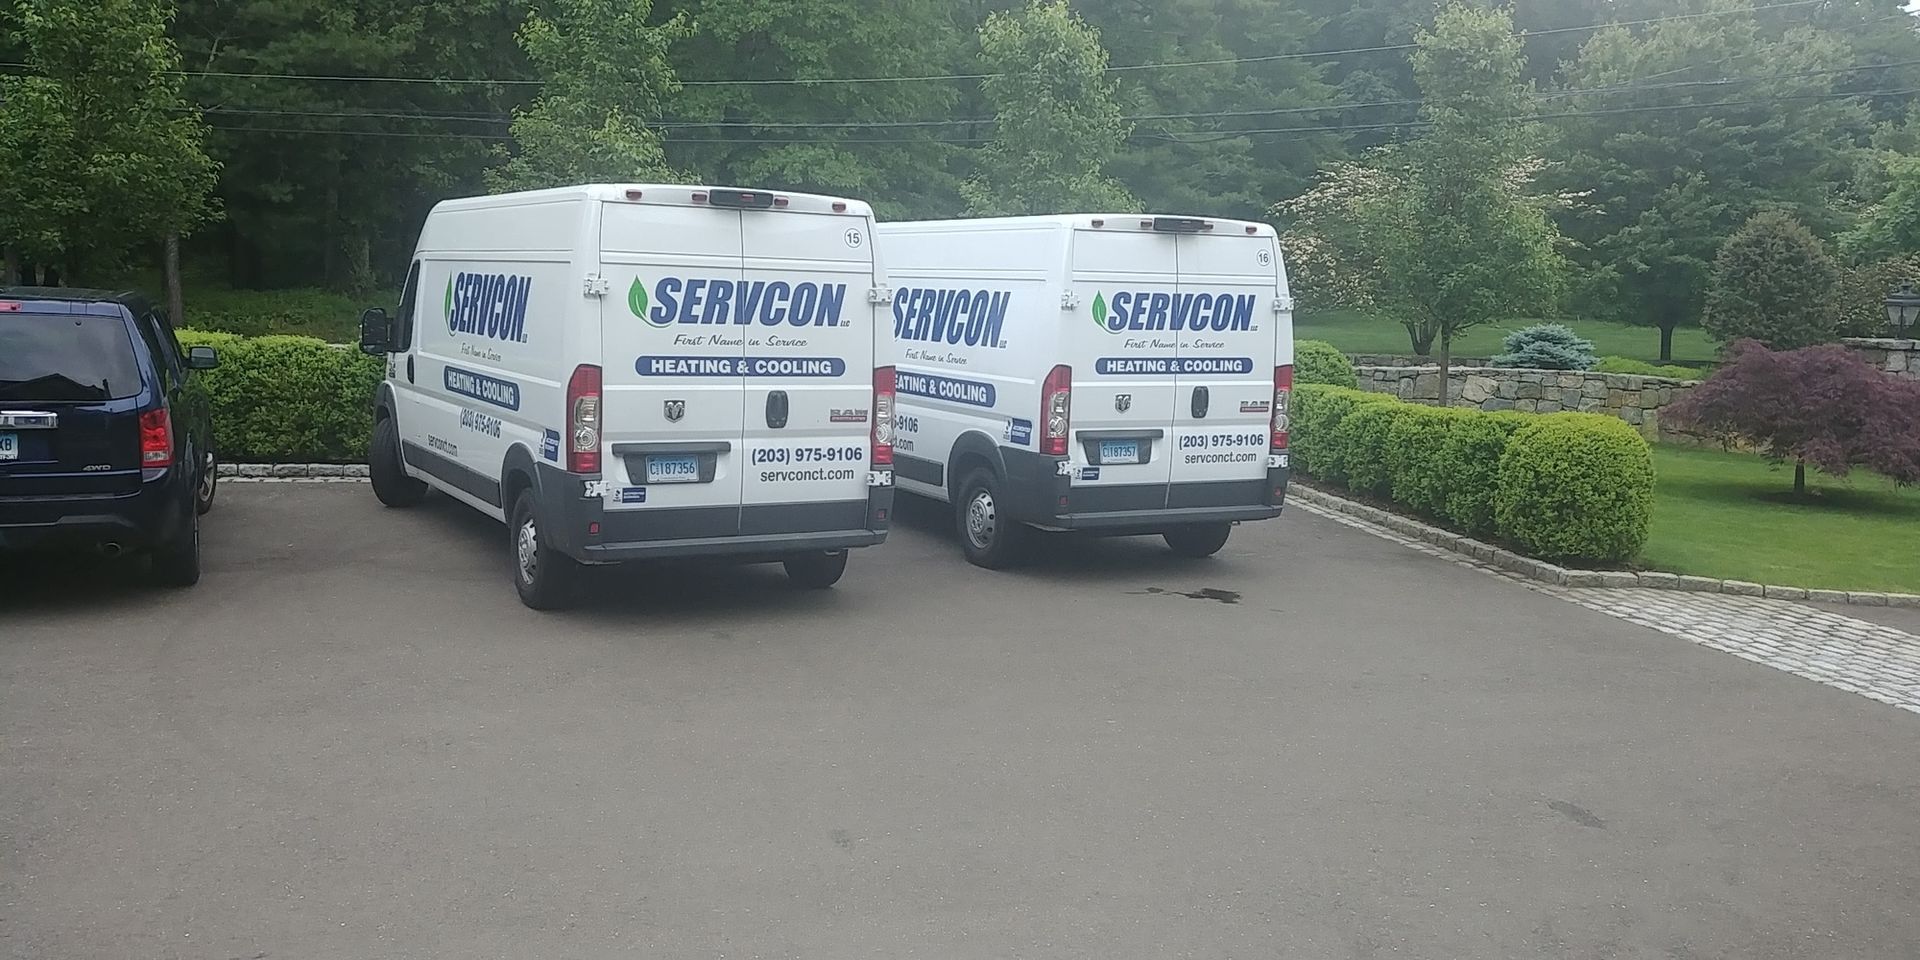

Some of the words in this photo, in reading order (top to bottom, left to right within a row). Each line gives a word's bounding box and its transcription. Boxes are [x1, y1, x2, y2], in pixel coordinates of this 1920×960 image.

[847, 232, 860, 245] 15
[1258, 252, 1269, 263] 16
[450, 272, 532, 342] SERVCON
[650, 277, 847, 327] SERVCON
[892, 287, 1011, 348] SERVCON
[1108, 291, 1256, 332] SERVCON
[673, 333, 706, 346] First
[708, 334, 744, 346] Name
[749, 337, 760, 347] in
[765, 335, 808, 347] Service
[1124, 338, 1148, 349] First
[1150, 338, 1176, 349] Name
[1180, 340, 1189, 349] in
[1193, 338, 1225, 349] Service
[651, 359, 731, 374] HEATING
[736, 360, 749, 374] &
[754, 359, 832, 375] COOLING
[1106, 360, 1167, 372] HEATING
[1170, 361, 1180, 372] &
[1184, 359, 1243, 372] COOLING
[447, 370, 475, 394] HEATING
[475, 378, 482, 396] &
[482, 380, 514, 406] COOLING
[929, 379, 936, 395] &
[939, 380, 987, 403] COOLING
[1179, 434, 1208, 451] (203)
[1212, 433, 1264, 447] 975-9106
[752, 448, 790, 466] (203)
[795, 447, 863, 462] 975-9106
[1184, 451, 1257, 464] servconct.com
[82, 464, 111, 472] 4WD
[760, 468, 854, 482] servconct.com
